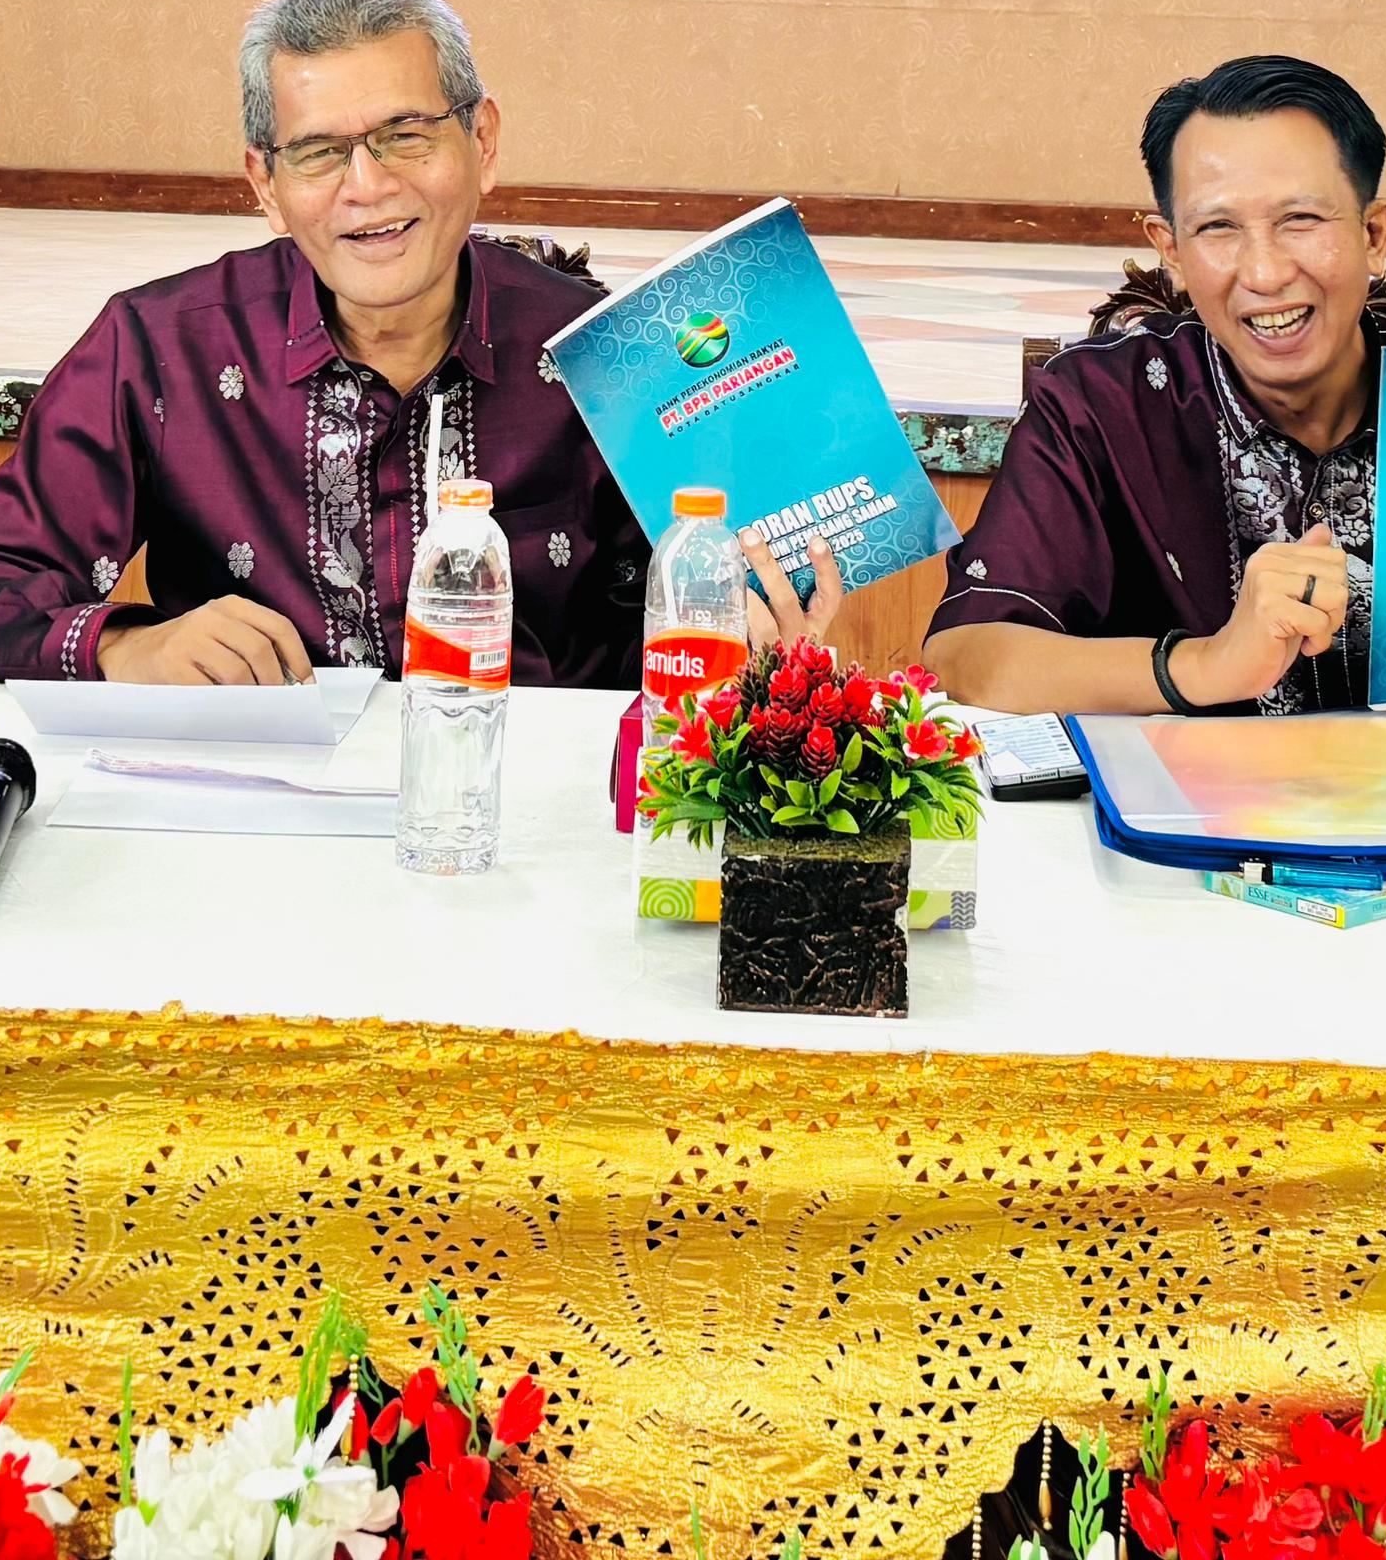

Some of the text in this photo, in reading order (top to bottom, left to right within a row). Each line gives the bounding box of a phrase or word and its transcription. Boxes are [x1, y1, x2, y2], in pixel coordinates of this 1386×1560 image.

[655, 338, 784, 416] BANK PEREKONOMIAN RAKYAT
[661, 347, 795, 429] PT. BPR PARIANGAN
[668, 363, 801, 438] KOTA BATUSANGKAR
[811, 475, 877, 521] RUPS
[852, 494, 899, 525] SAHAM
[832, 528, 866, 554] 2025
[645, 648, 706, 679] amidis
[1248, 887, 1270, 902] ESSE
